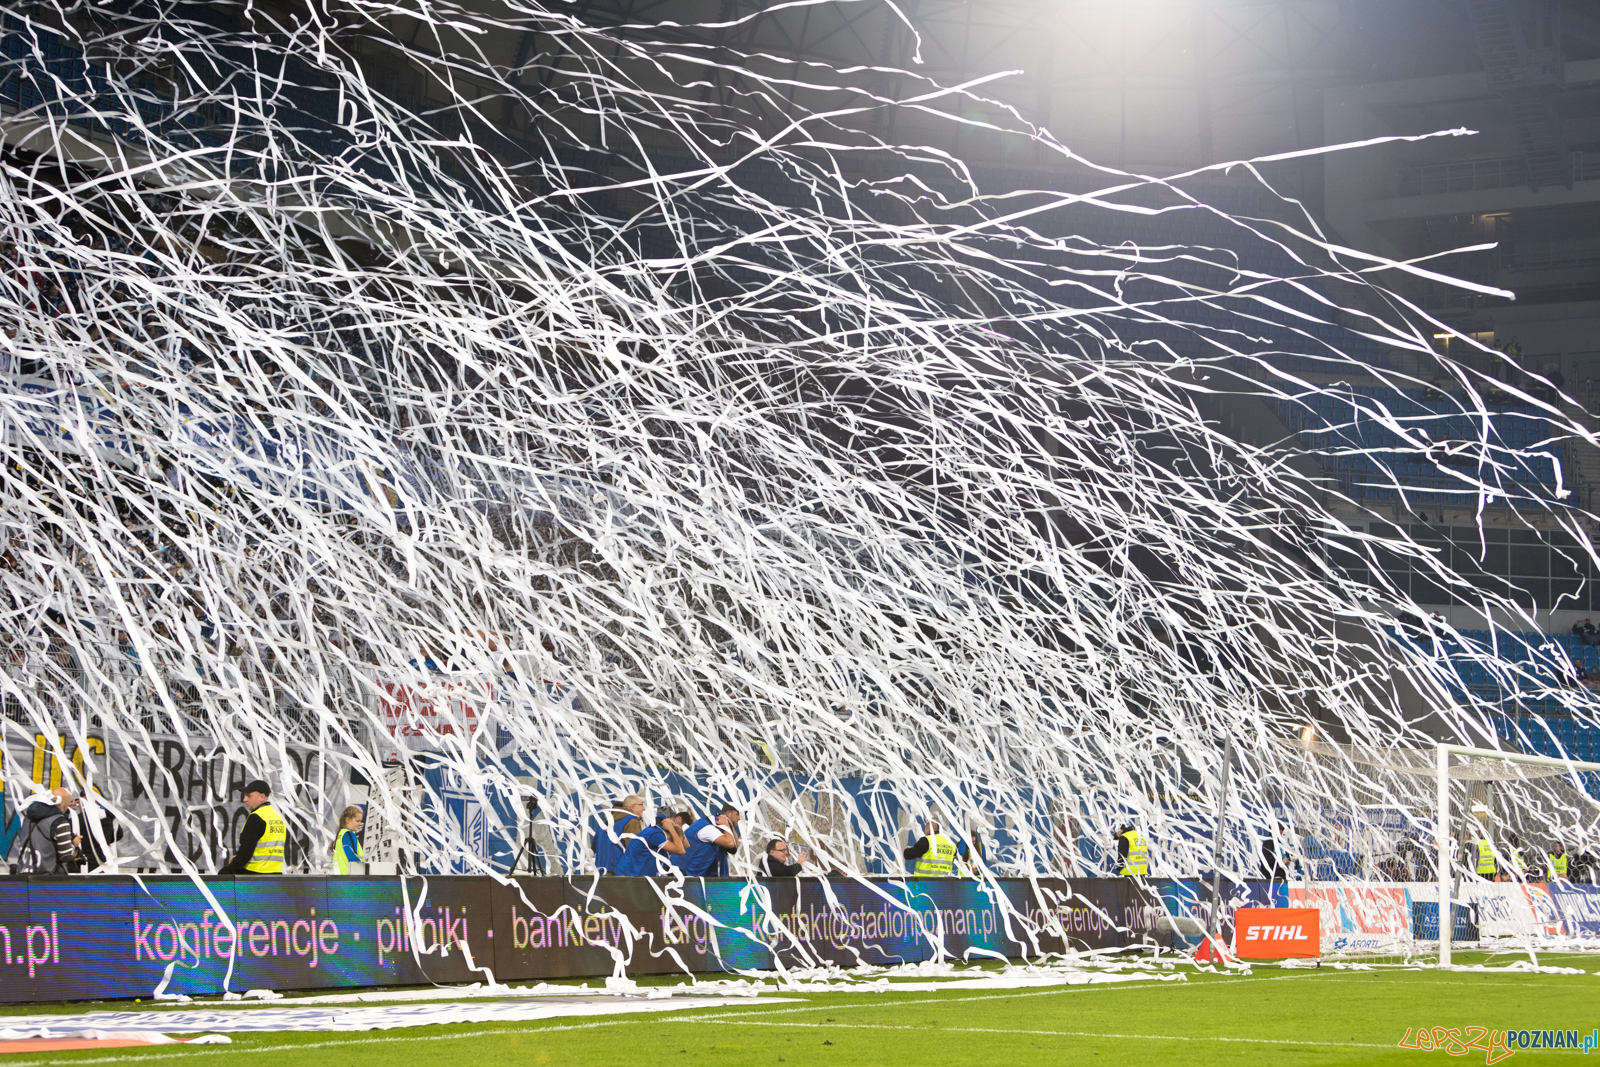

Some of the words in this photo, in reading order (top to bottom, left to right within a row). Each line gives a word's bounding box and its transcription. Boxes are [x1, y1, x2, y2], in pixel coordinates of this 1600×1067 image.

[133, 907, 339, 968] konferencje
[512, 904, 623, 954] bankiety
[660, 904, 713, 954] targi
[1245, 925, 1308, 940] STIHL
[1350, 940, 1379, 949] AFORTI
